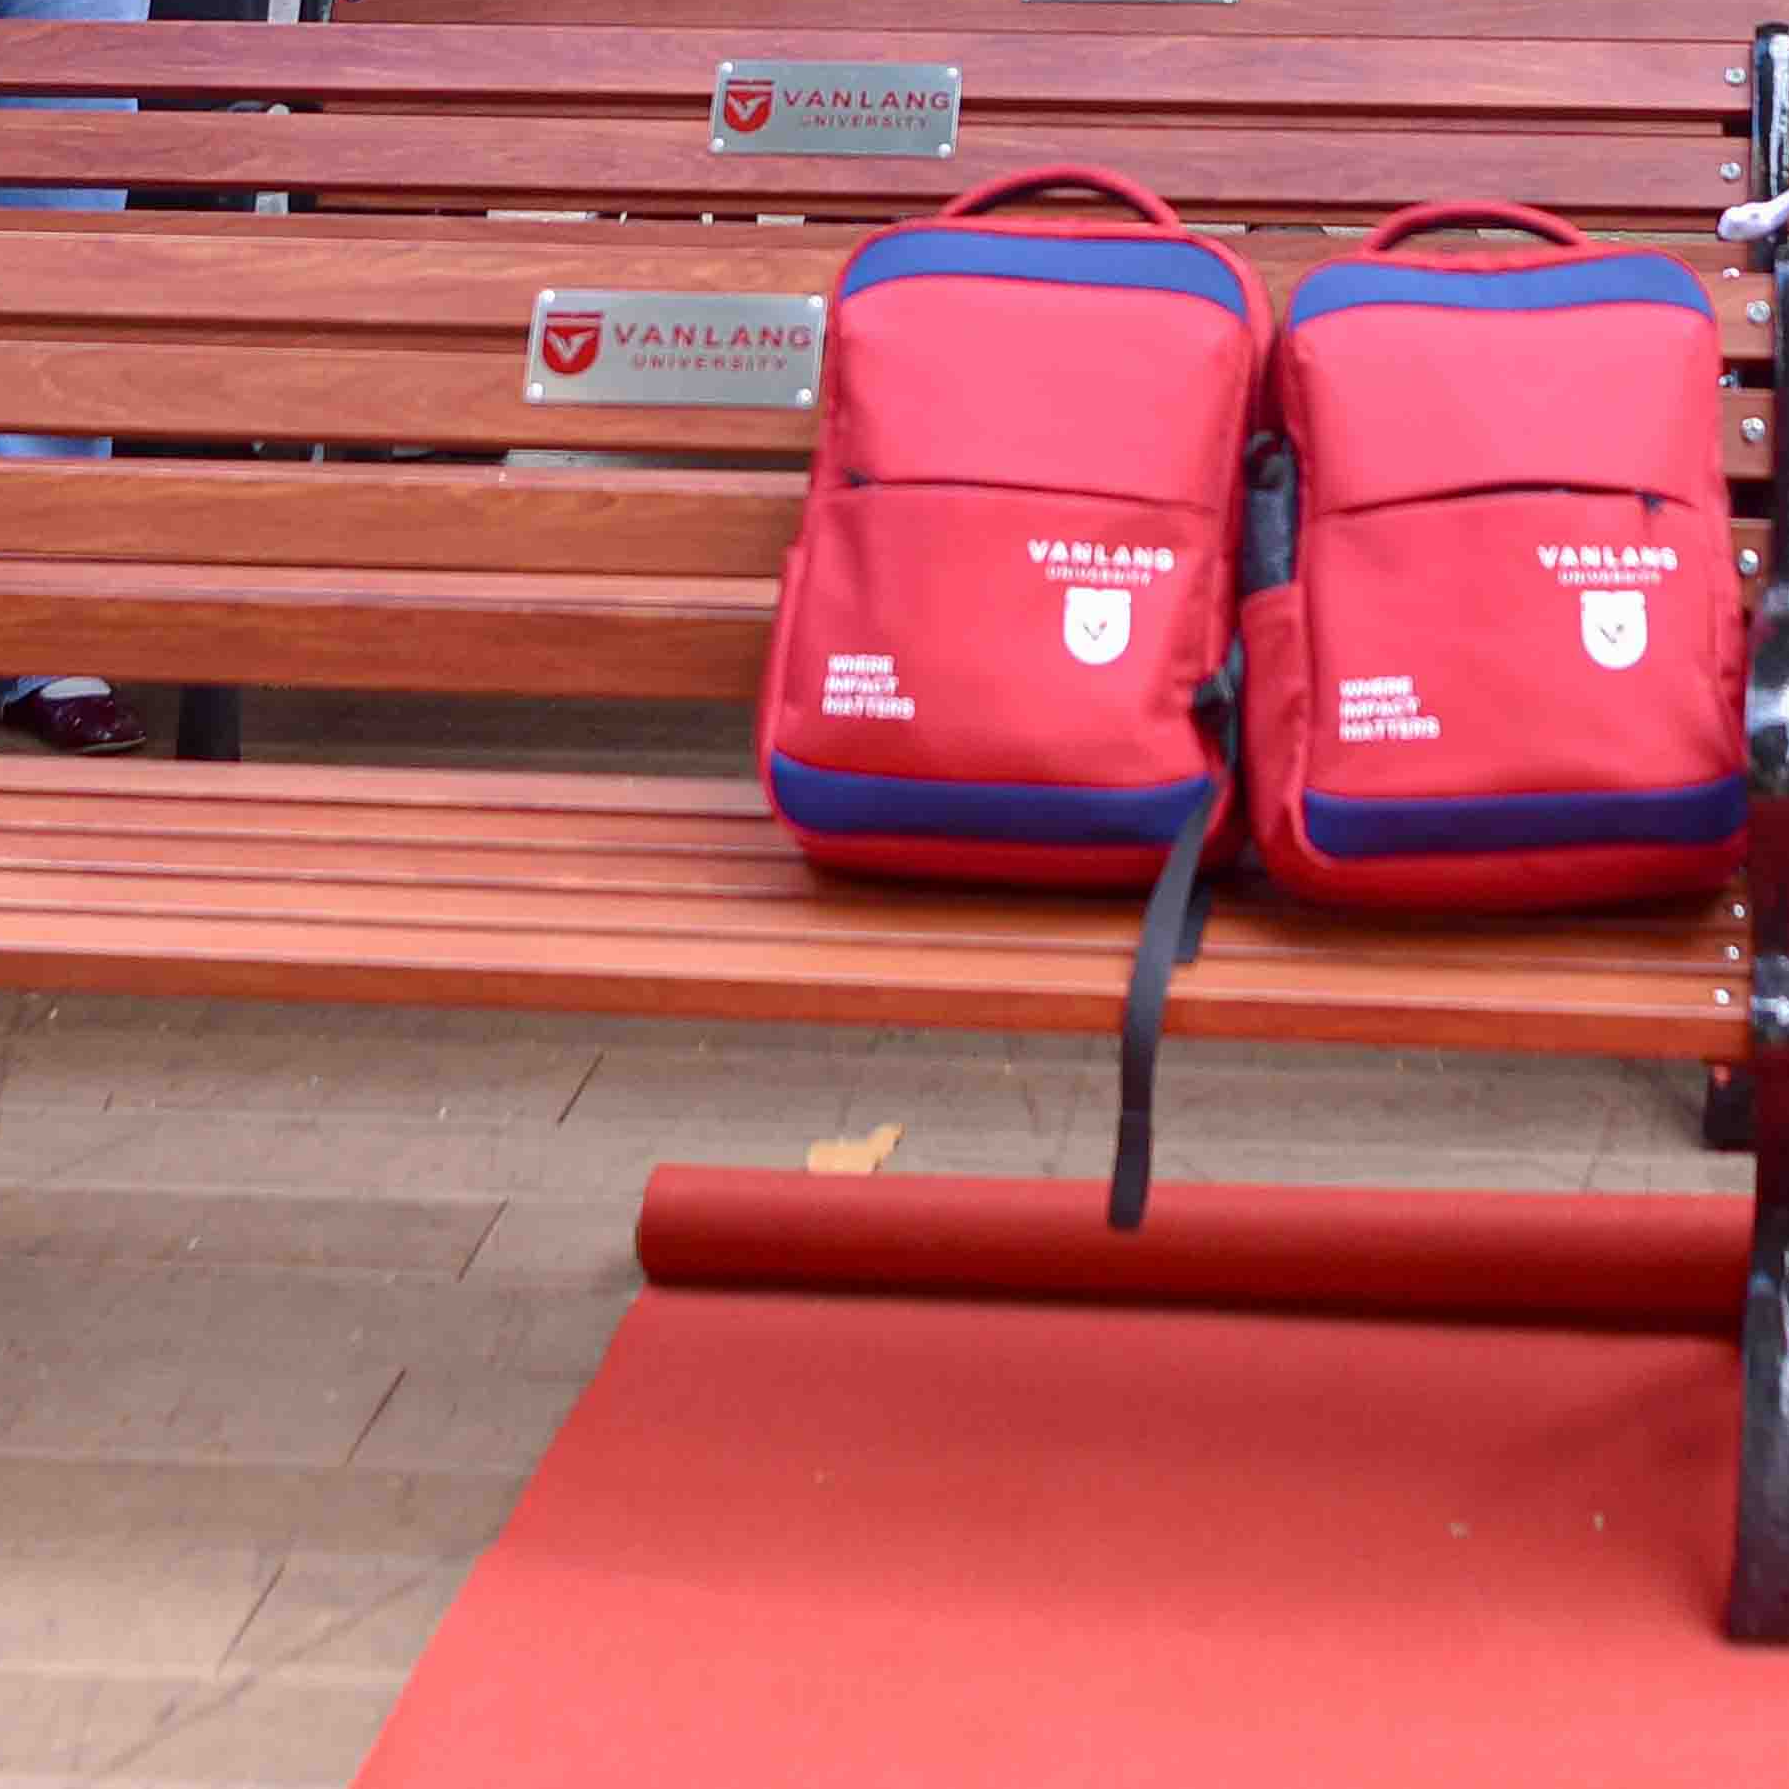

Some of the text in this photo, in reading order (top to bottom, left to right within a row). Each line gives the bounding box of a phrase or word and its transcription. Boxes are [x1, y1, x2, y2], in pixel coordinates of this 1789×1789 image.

[782, 89, 951, 110] VANLANG
[613, 323, 812, 349] VANLANG
[630, 354, 788, 370] UNIVERSITY
[1027, 539, 1174, 571] VANLANG
[1536, 545, 1679, 571] VANLANG
